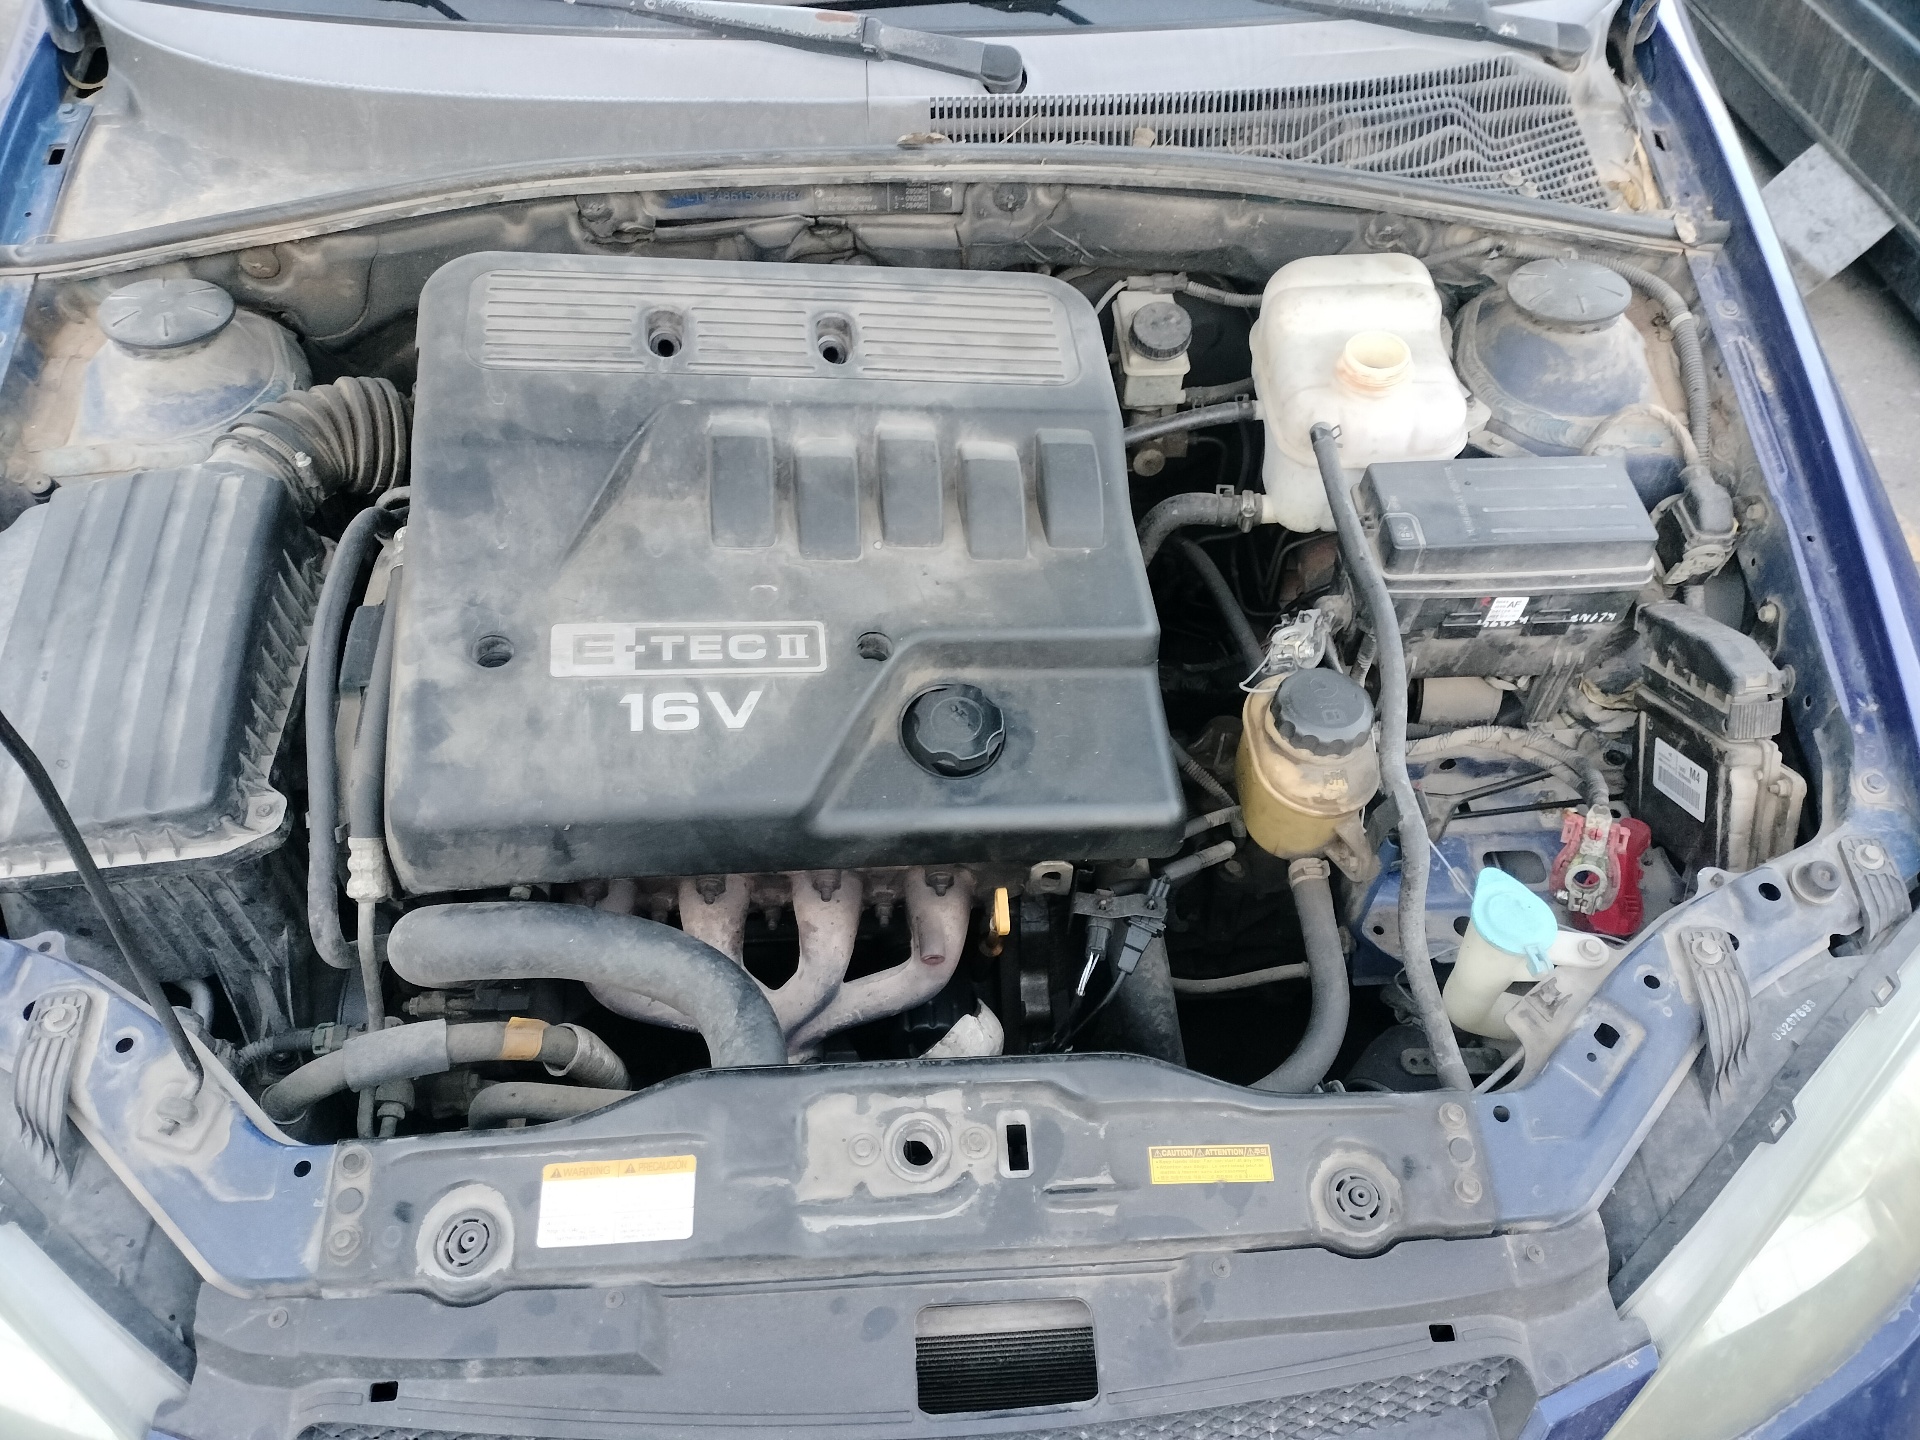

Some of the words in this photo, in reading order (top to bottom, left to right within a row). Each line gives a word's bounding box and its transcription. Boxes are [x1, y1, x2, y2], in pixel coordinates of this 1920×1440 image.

[1507, 600, 1522, 609] AF
[619, 690, 763, 732] 16V
[1689, 766, 1701, 784] M4
[563, 1165, 611, 1178] WARNING
[638, 1158, 688, 1172] PRECAUCIÓN
